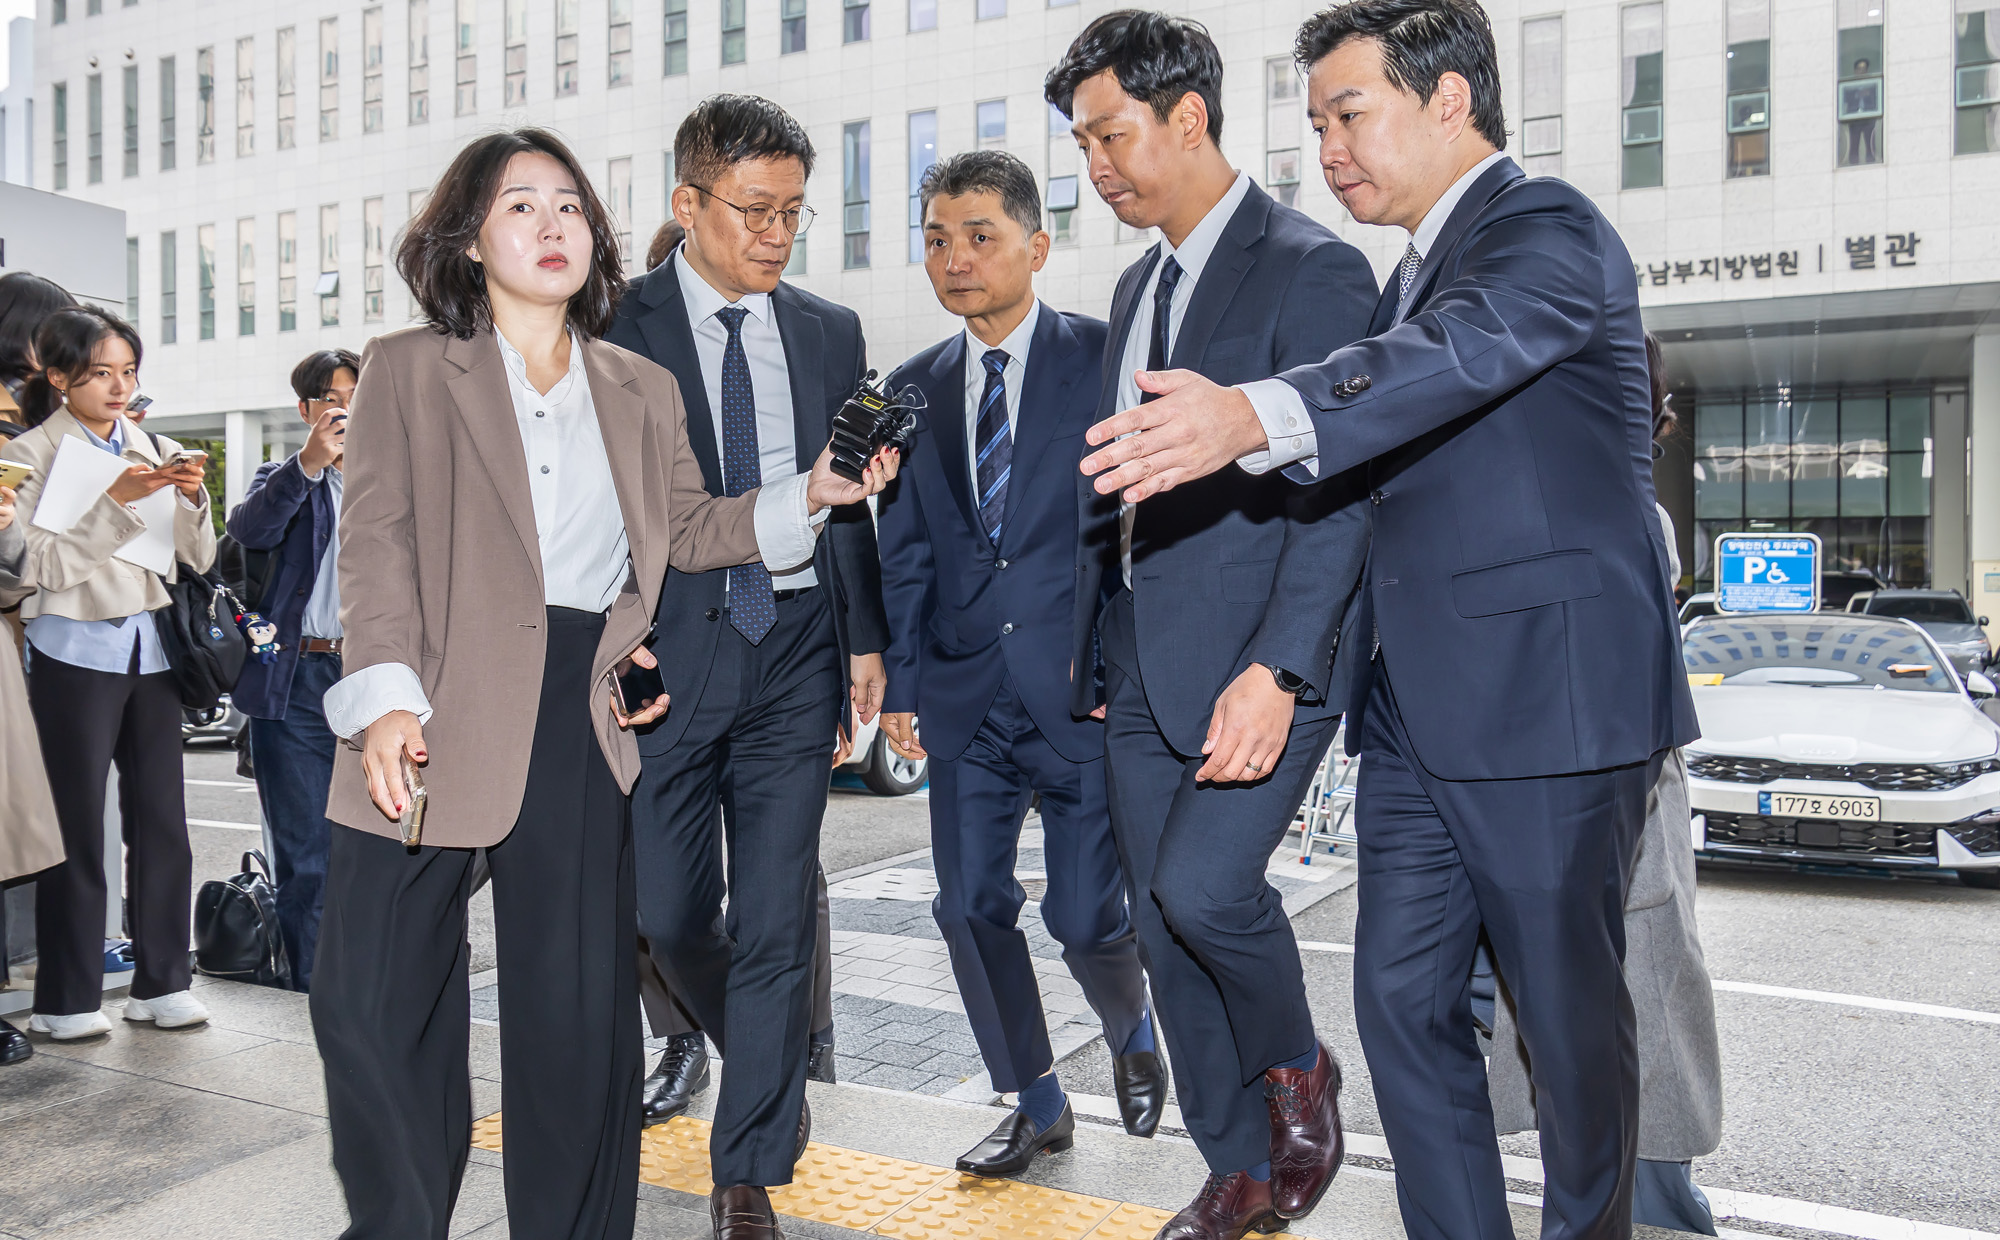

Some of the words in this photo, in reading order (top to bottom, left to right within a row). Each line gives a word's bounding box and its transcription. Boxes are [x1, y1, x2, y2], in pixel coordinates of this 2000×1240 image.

[1845, 232, 1921, 270] 별관
[1744, 557, 1767, 583] P
[1775, 797, 1822, 814] 177호
[1828, 799, 1874, 817] 6903
